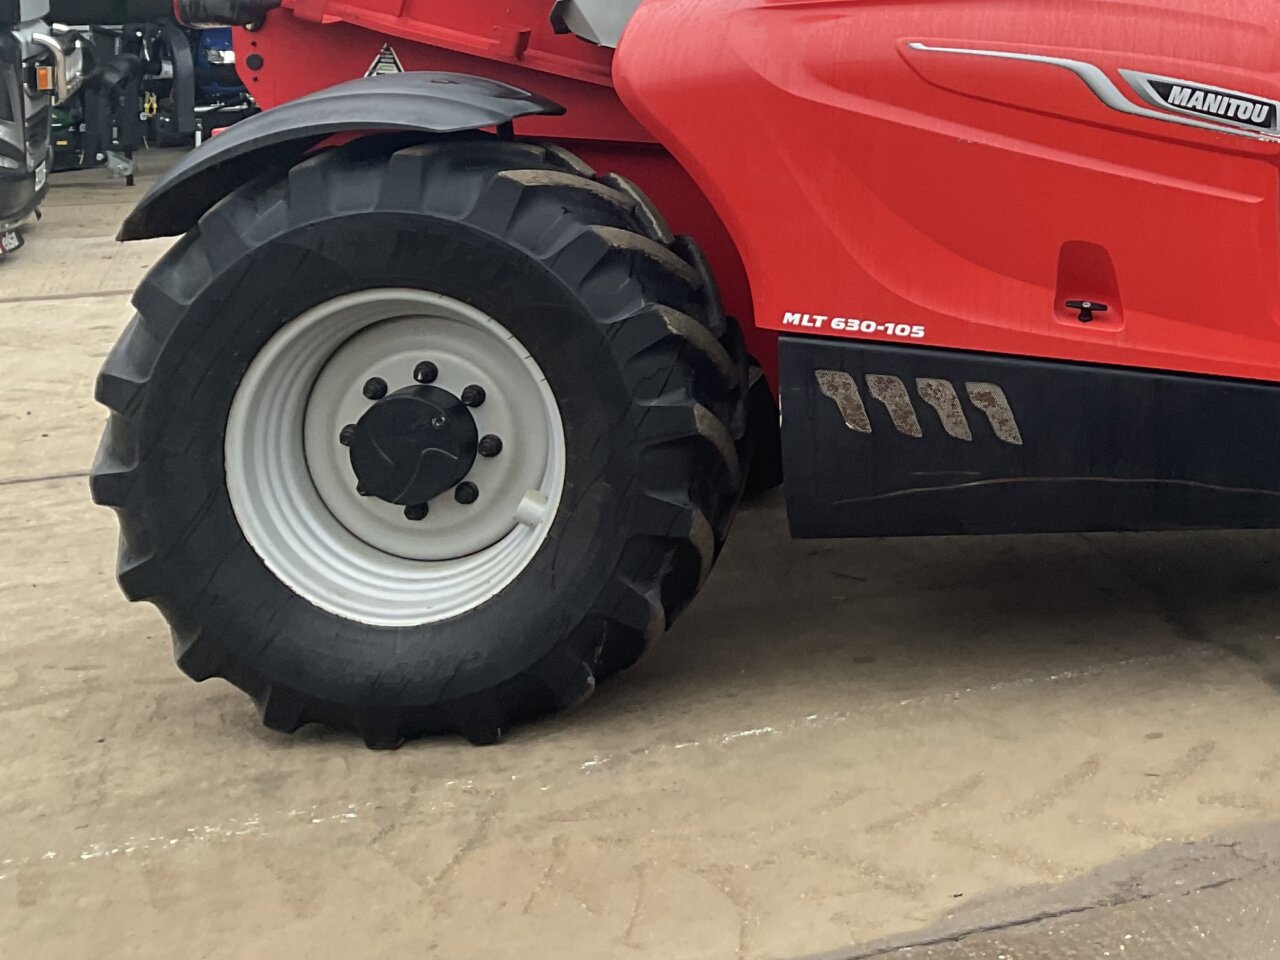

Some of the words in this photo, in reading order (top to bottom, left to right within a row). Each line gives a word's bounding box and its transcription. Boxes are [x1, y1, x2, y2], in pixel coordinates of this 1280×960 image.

[1167, 85, 1269, 123] MANITOU
[782, 312, 828, 327] MLT
[830, 317, 925, 338] 630-105
